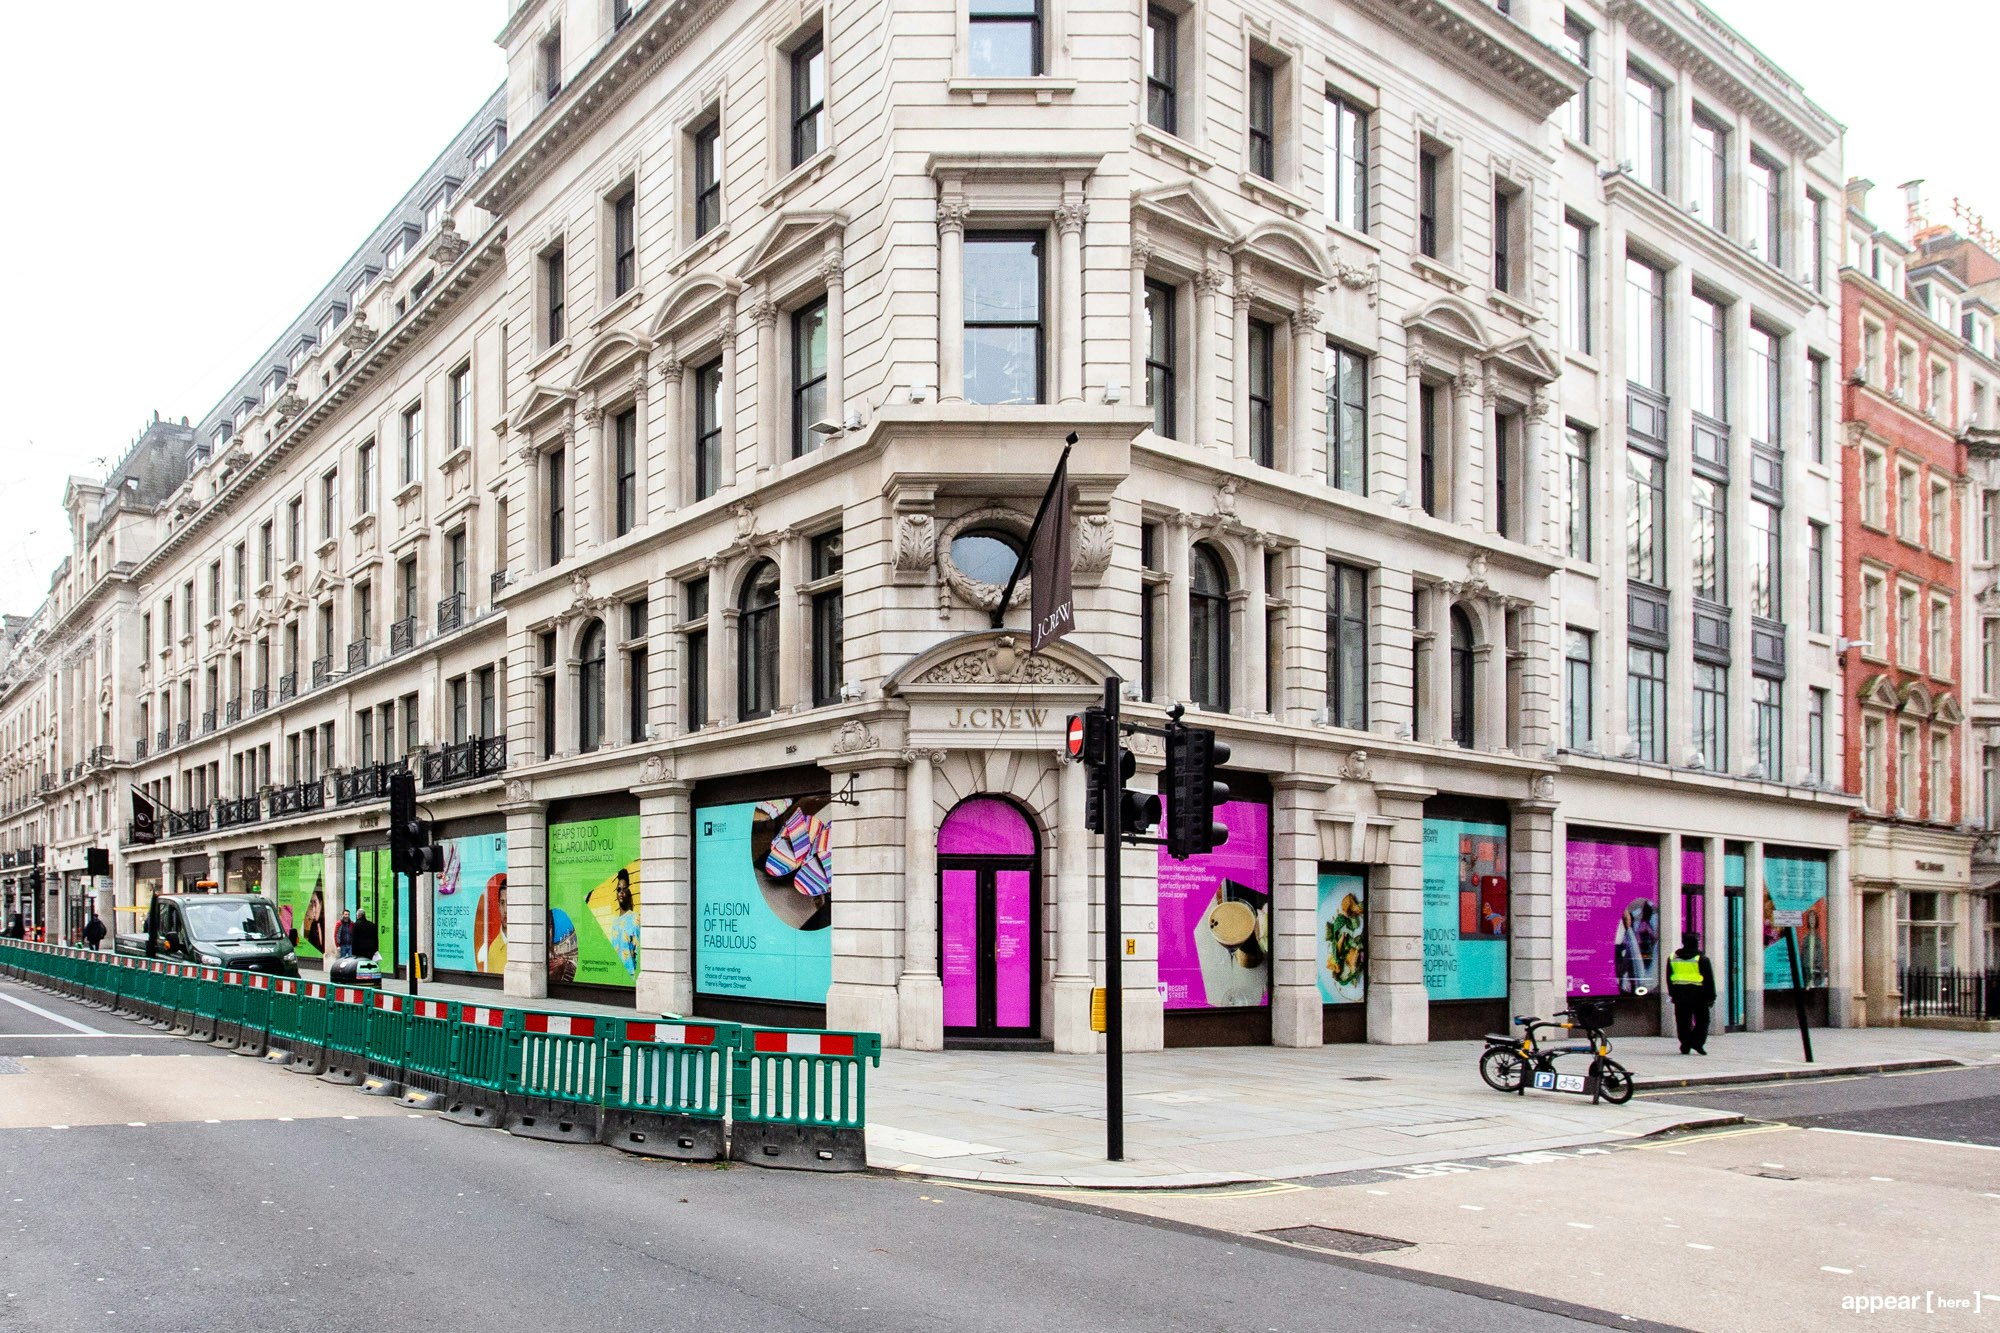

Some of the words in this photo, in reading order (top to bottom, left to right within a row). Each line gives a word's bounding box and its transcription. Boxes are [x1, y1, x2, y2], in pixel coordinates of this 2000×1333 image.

[949, 708, 1049, 728] J.CREW
[553, 827, 576, 840] HEAPS
[577, 826, 585, 838] TO
[588, 825, 598, 837] DO
[1423, 827, 1438, 835] ROWN
[552, 843, 564, 854] ALL
[566, 840, 596, 852] AROUND
[598, 838, 614, 850] YOU
[1581, 881, 1617, 895] WELLNESS
[437, 906, 453, 916] WHERE
[454, 905, 470, 916] DRESS
[704, 903, 711, 915] A
[713, 903, 750, 916] FUSION
[1567, 908, 1591, 921] STREET
[442, 917, 457, 927] NEVER
[704, 919, 717, 931] OF
[719, 919, 738, 932] THE
[441, 928, 468, 940] REHEARSAL
[704, 934, 757, 949] FABULOUS
[1423, 944, 1455, 957] RIGINAL
[1423, 959, 1457, 972] HOPPING
[1423, 974, 1447, 988] TREET
[1168, 991, 1188, 999] STREET
